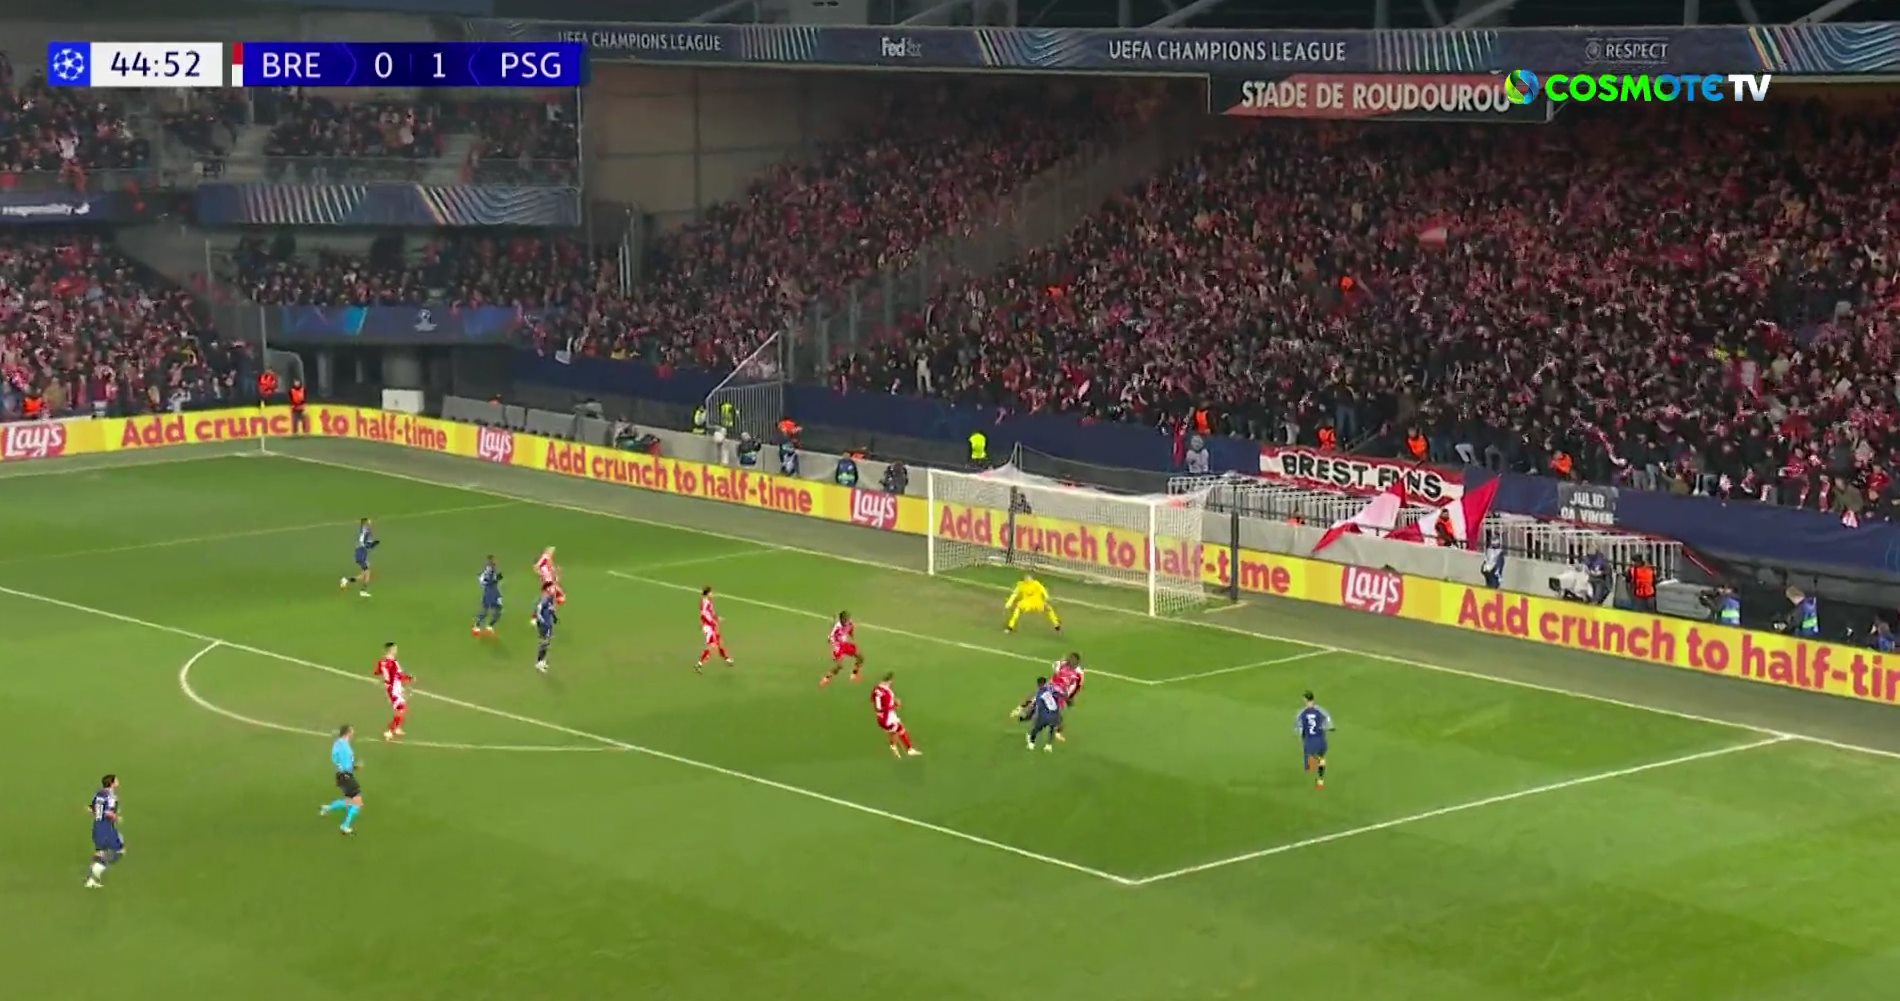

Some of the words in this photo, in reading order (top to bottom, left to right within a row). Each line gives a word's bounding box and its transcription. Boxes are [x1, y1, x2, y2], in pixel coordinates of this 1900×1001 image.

[591, 32, 668, 50] CHAMPIONS
[670, 34, 722, 51] LEAGUE
[1108, 40, 1152, 60] UEFA
[1157, 41, 1267, 61] CHAMPIONS
[1272, 42, 1346, 61] LEAGUE
[1604, 42, 1668, 59] RESPECT
[1241, 80, 1307, 108] STADE
[1316, 82, 1344, 108] DE
[1352, 82, 1511, 112] ROUDOUROU
[121, 415, 187, 448] Add
[319, 409, 349, 436] to
[356, 409, 448, 450] half-time
[545, 440, 586, 475] Add
[592, 456, 668, 490] crunch
[674, 465, 697, 493] to
[702, 465, 813, 514] half-time
[1281, 453, 1369, 487] BREST
[939, 505, 992, 546] Add
[999, 517, 1099, 562] crunch
[1106, 532, 1136, 569] to
[1144, 536, 1291, 593] half-tme
[1457, 588, 1529, 637] Add
[1539, 611, 1676, 663] crunch
[1687, 627, 1730, 672] to
